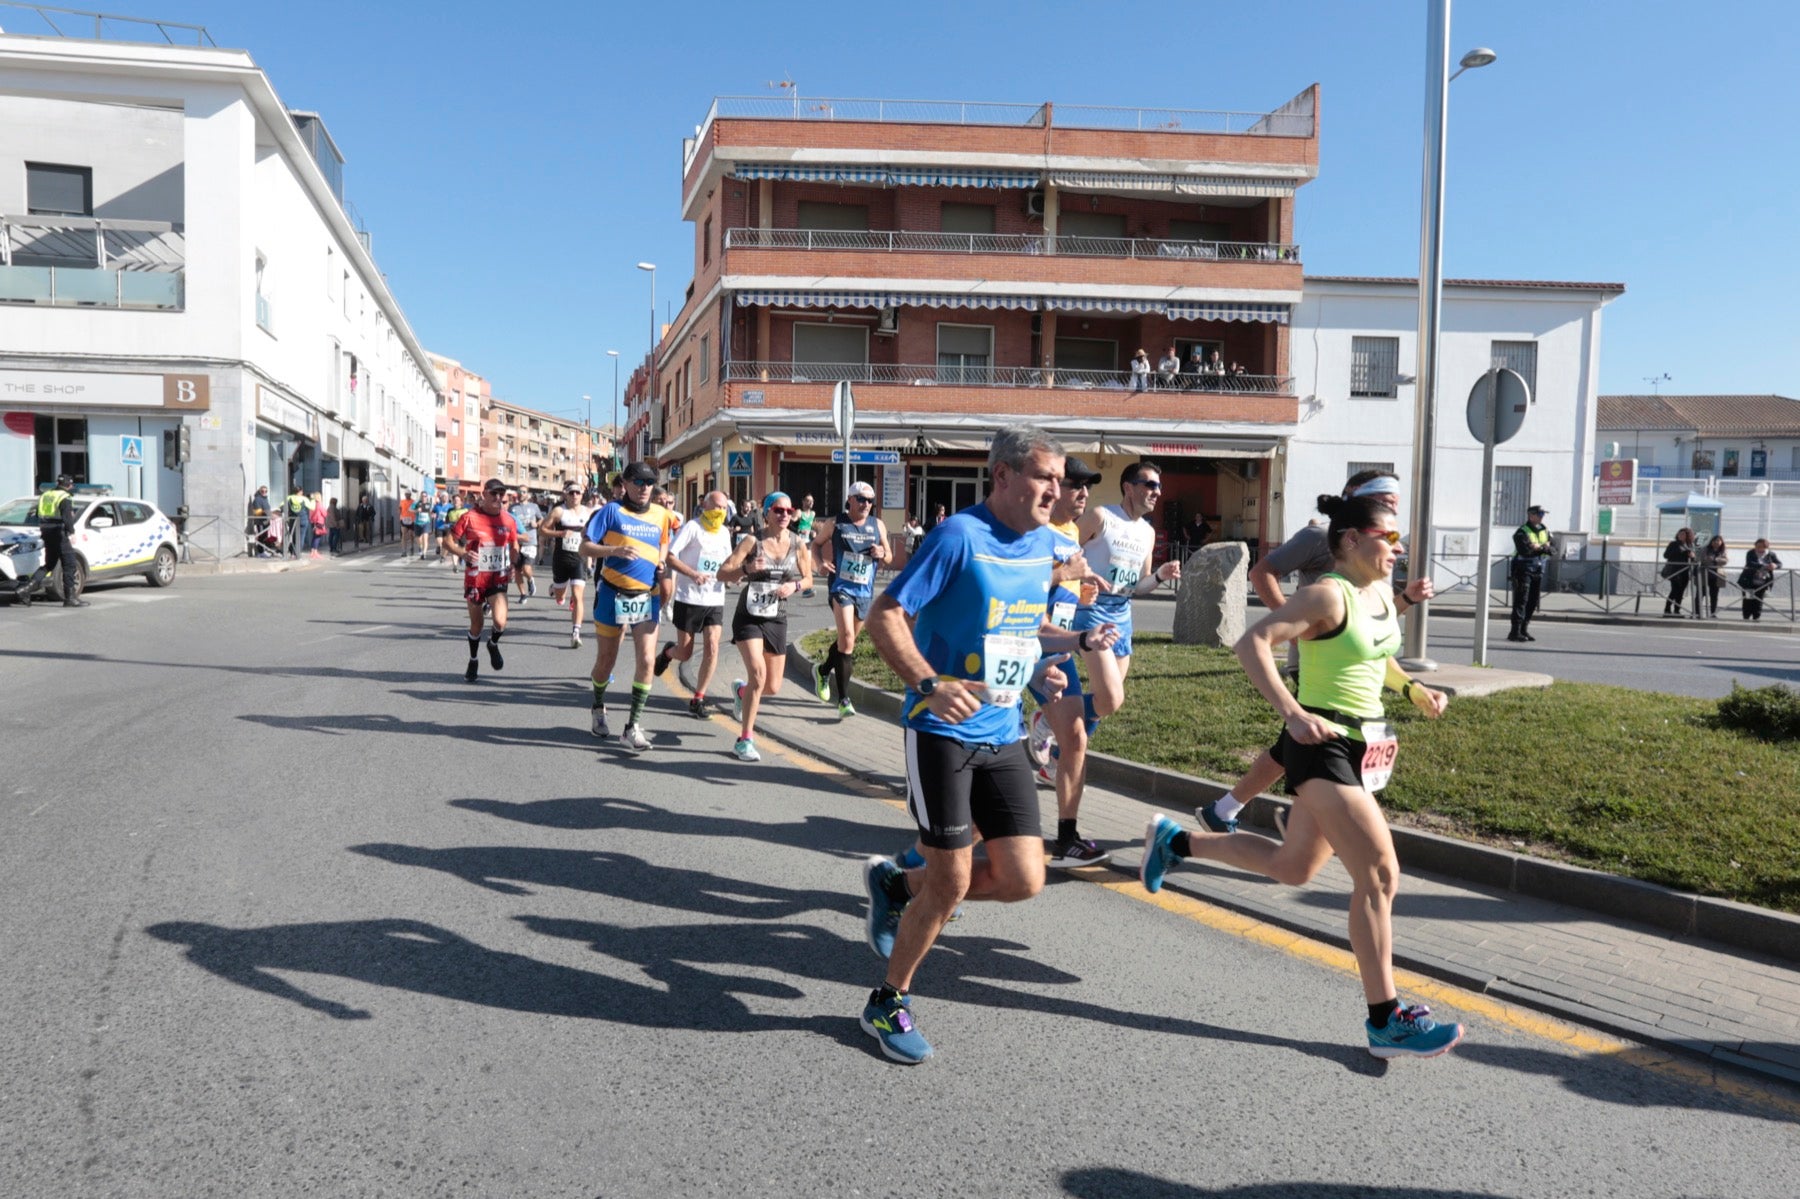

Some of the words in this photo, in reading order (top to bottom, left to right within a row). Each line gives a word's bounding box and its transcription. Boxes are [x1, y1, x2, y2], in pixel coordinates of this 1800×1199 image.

[5, 383, 35, 393] THE
[43, 384, 85, 394] SHOP
[846, 562, 867, 575] 748
[1110, 567, 1138, 586] 1040
[622, 601, 646, 613] 507
[996, 659, 1026, 686] 521
[1364, 744, 1395, 769] 2219
